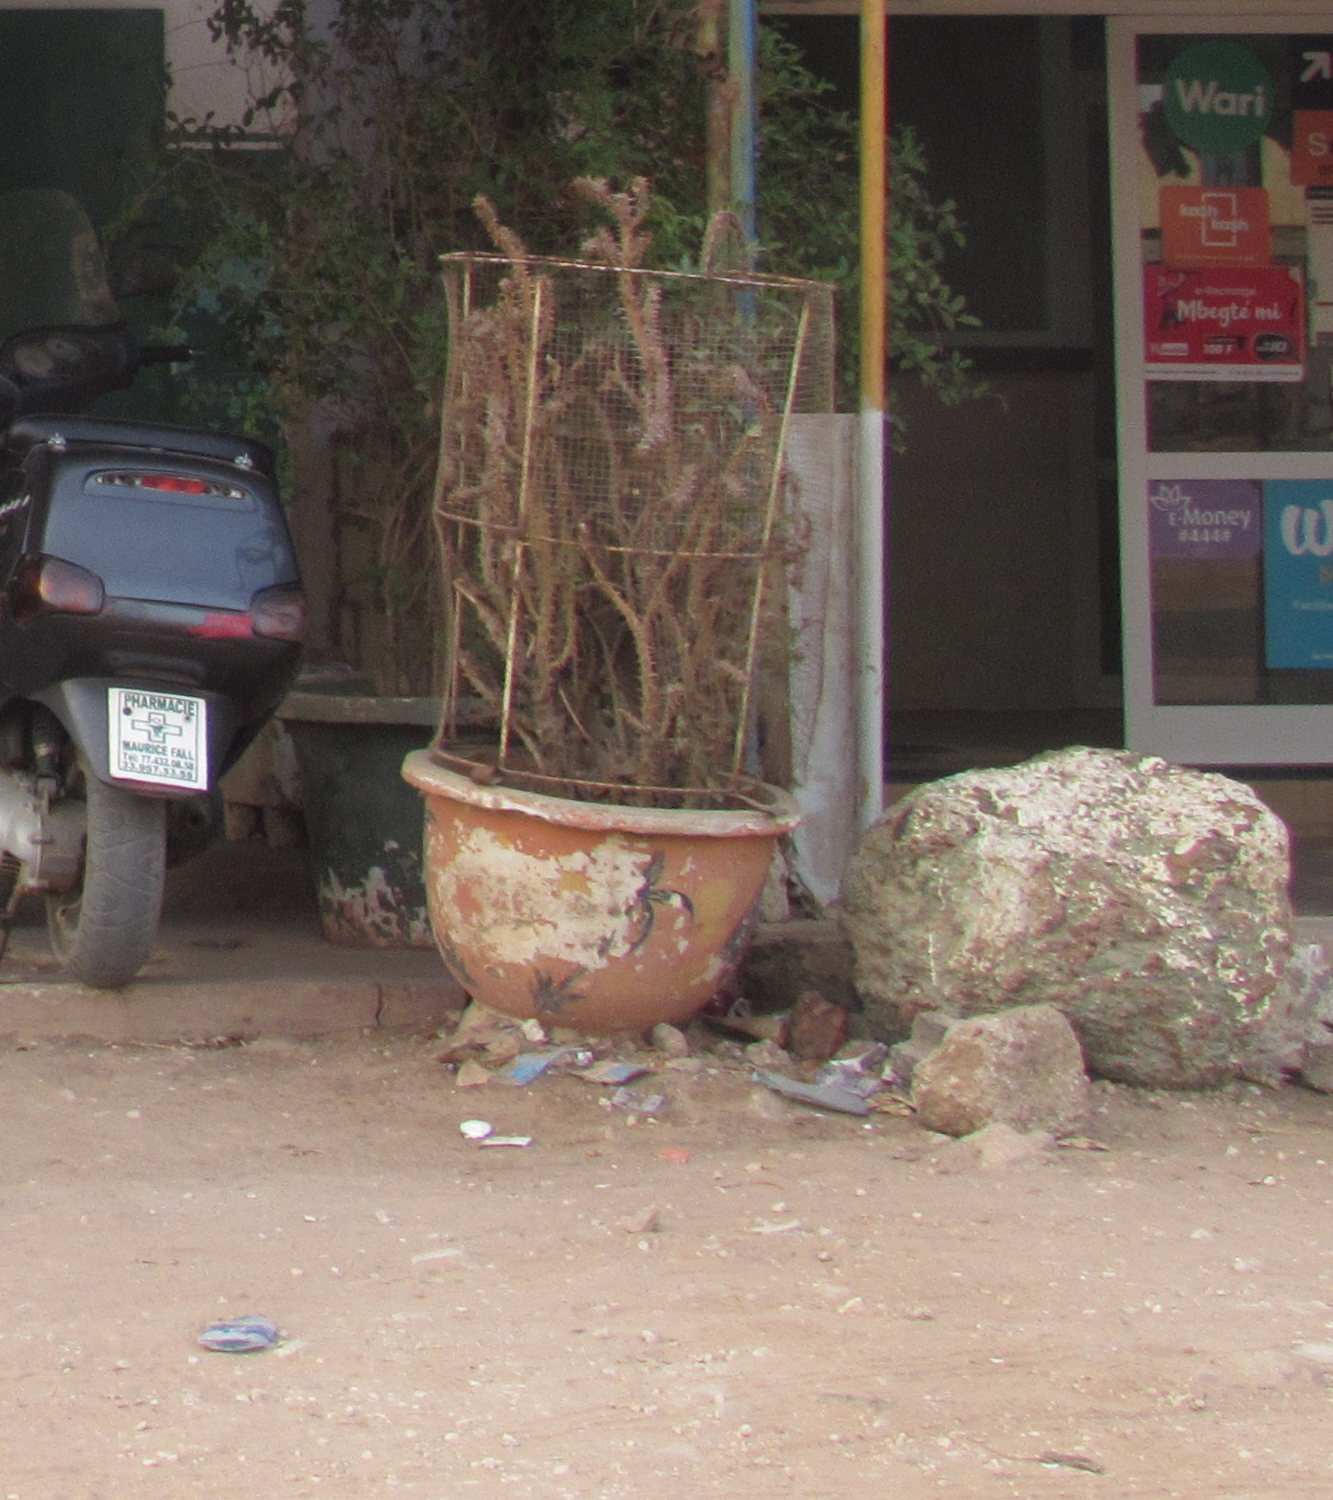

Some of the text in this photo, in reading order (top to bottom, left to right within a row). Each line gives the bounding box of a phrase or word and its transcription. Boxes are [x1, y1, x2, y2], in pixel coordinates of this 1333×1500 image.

[1174, 78, 1266, 118] Wari
[1169, 507, 1251, 529] E-Money
[123, 693, 196, 716] PHARMACIE
[122, 741, 194, 761] MAURICE FALL
